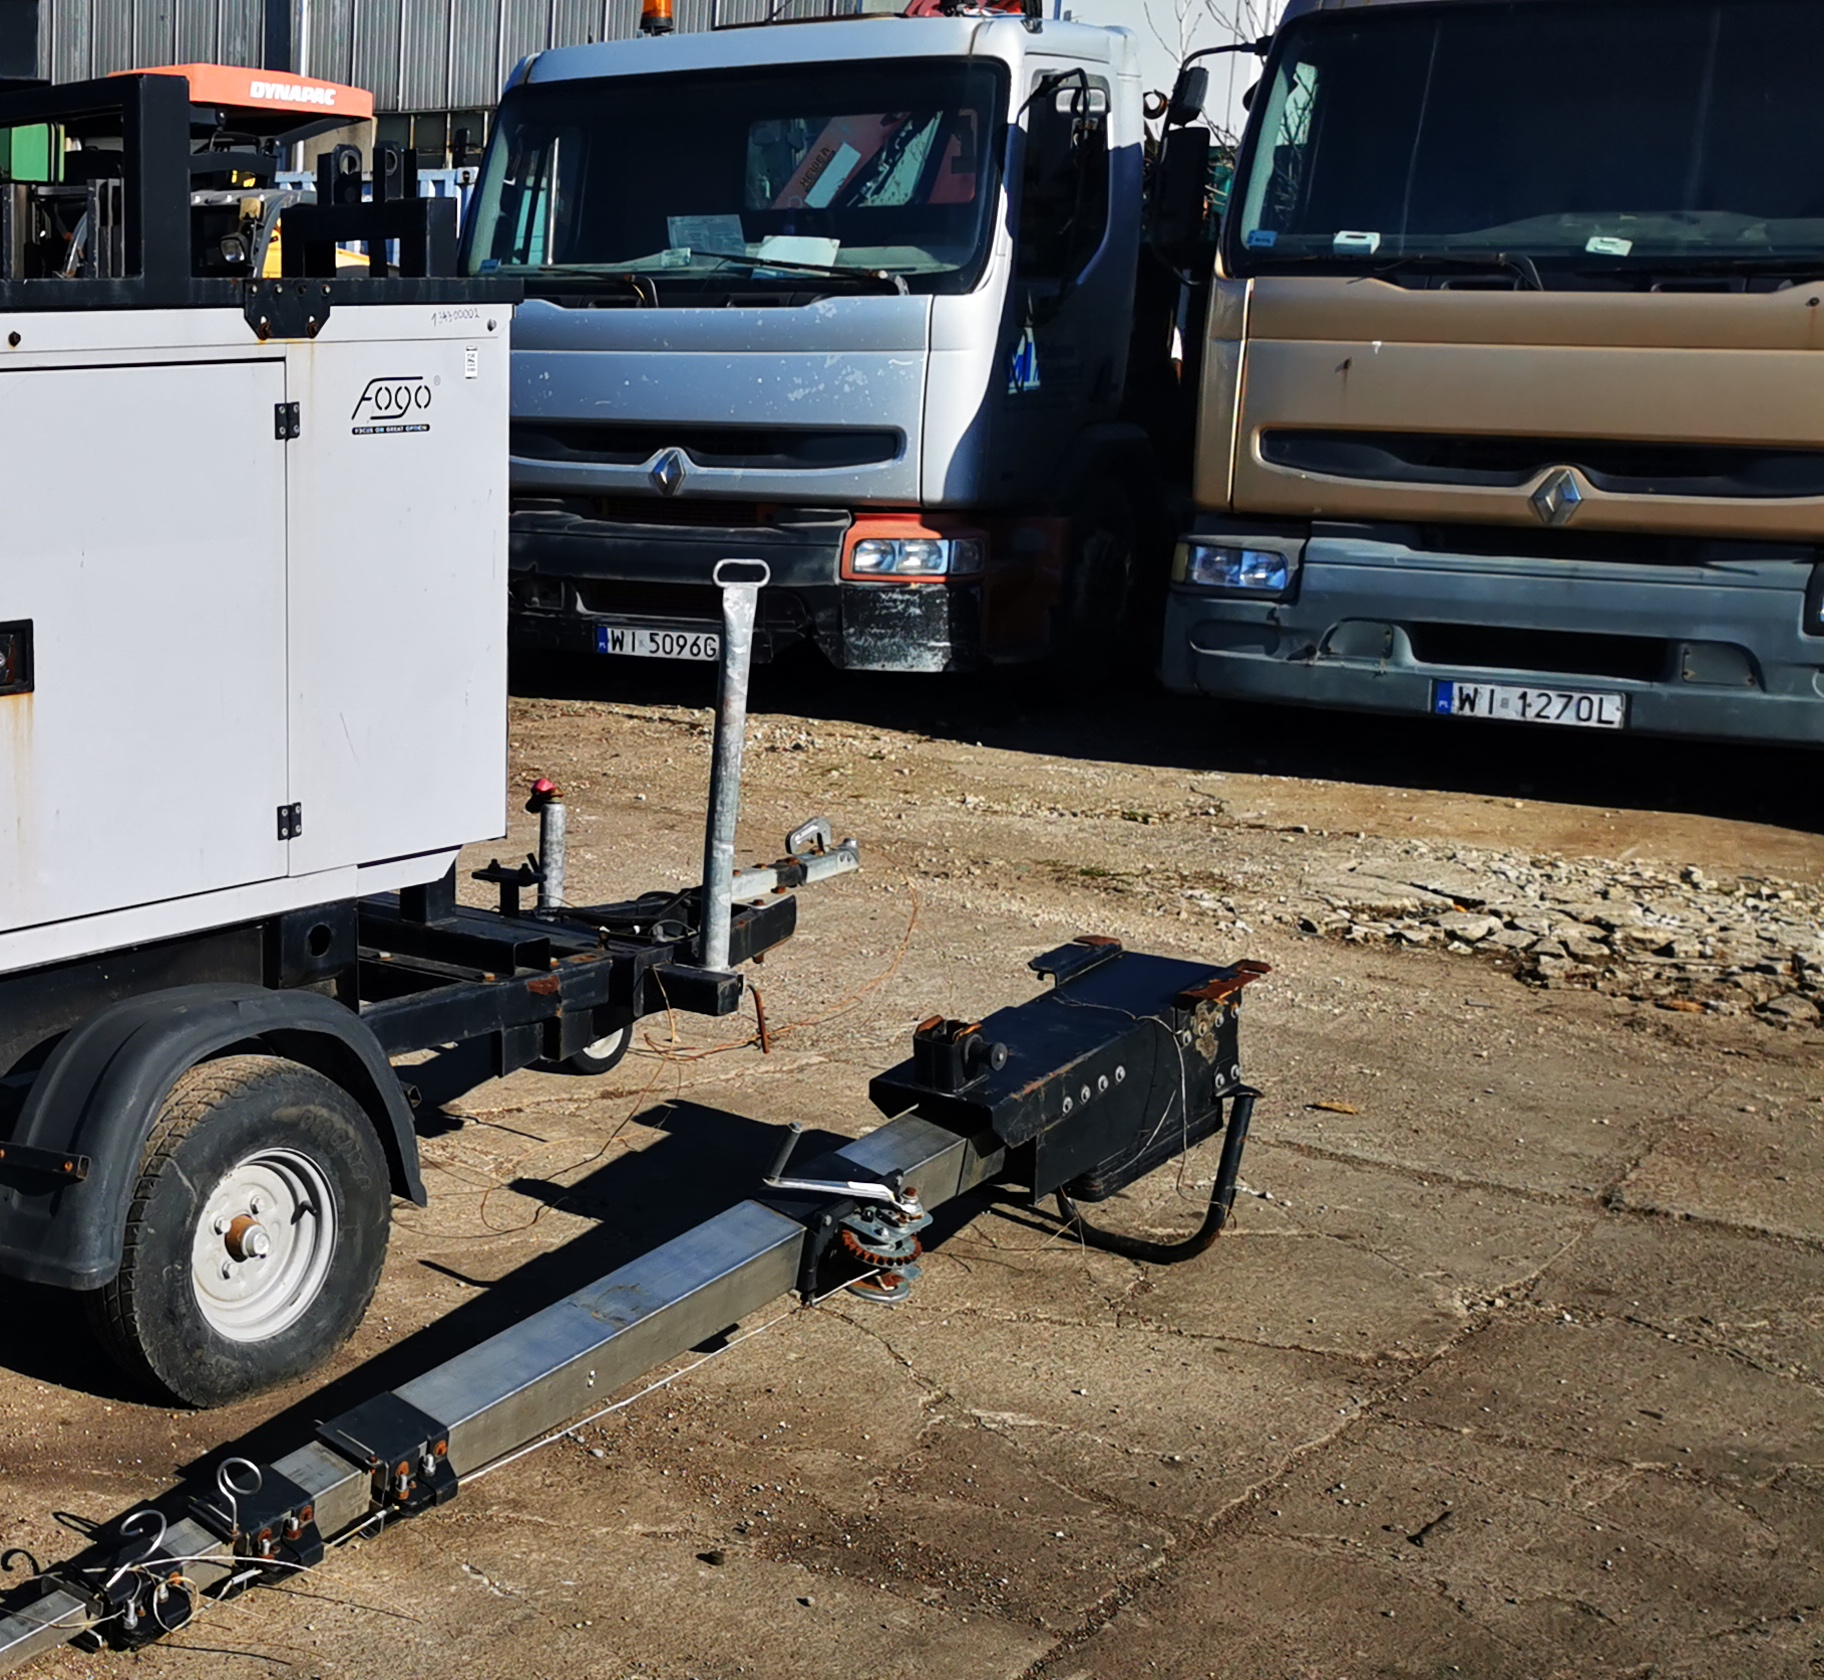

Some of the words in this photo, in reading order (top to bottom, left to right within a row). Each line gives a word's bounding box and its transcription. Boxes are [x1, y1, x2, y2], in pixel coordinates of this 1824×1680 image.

[250, 81, 336, 106] DYNAPAC
[610, 629, 636, 653] WI
[649, 632, 717, 658] 5096G
[1458, 686, 1495, 715] WI
[1517, 690, 1615, 725] 1270L
